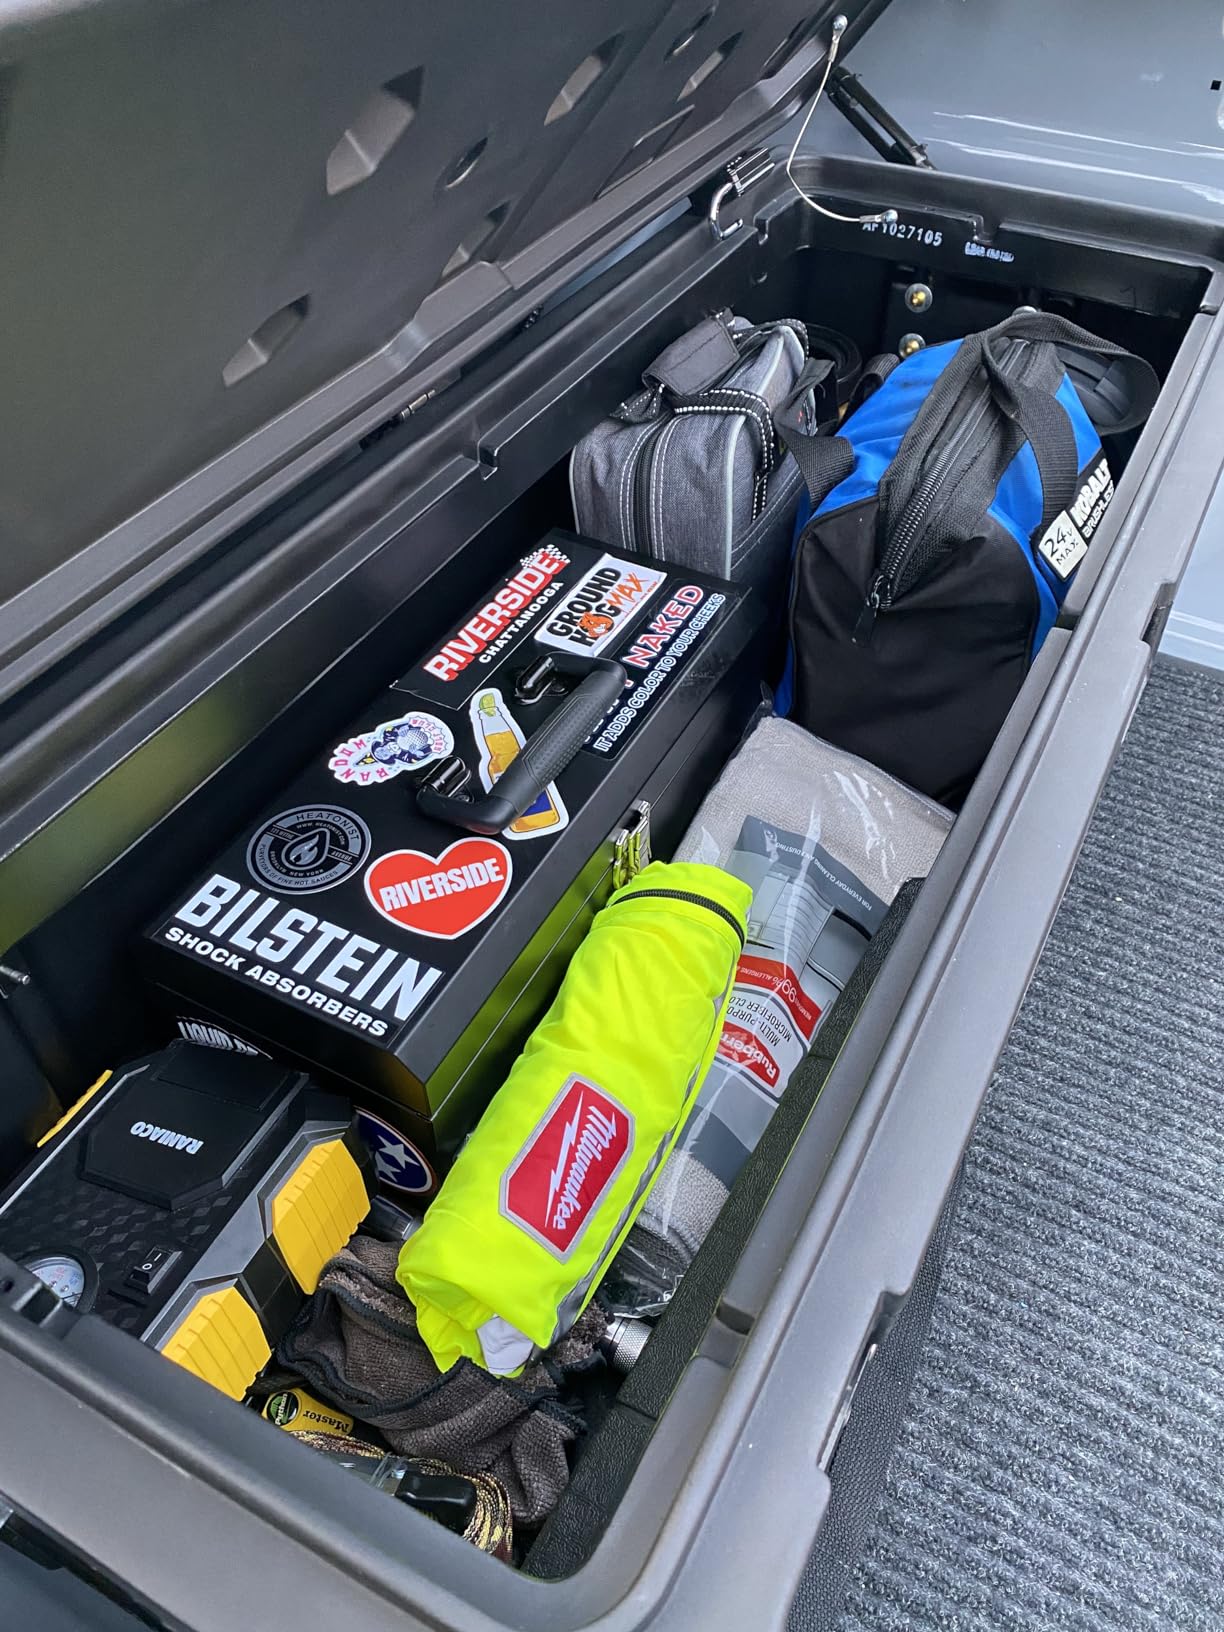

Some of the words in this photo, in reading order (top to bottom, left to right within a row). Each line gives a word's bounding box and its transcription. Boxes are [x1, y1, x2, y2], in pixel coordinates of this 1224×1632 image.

[1070, 458, 1112, 528] KOBALT
[1056, 539, 1079, 565] MAX
[546, 567, 622, 637] GROUND
[605, 572, 650, 608] MAX
[423, 550, 568, 681] RIVERSIDE
[479, 581, 565, 664] CHATTANOOGA
[622, 585, 704, 668] NAKED
[689, 592, 727, 632] CHEEKS
[667, 628, 700, 659] YOUR
[655, 656, 677, 673] TO
[628, 671, 667, 707] COLOR
[601, 706, 637, 741] ADDS
[334, 738, 390, 782] RANDOM
[593, 736, 613, 753] IT
[295, 811, 360, 841] HEATONIST
[294, 879, 309, 887] HOT
[311, 870, 339, 885] SAUCES
[306, 868, 325, 877] YORK
[378, 857, 504, 912] RIVERSIDE
[812, 858, 837, 883] CLEANING
[834, 879, 863, 903] EVERYDAY
[861, 899, 873, 911] FOR
[174, 873, 443, 1022] BILSTEIN
[164, 926, 247, 971] SHOCK
[244, 964, 389, 1037] ABSORBERS
[728, 995, 746, 1007] CLO
[726, 1005, 781, 1047] MULTI-PURPO
[746, 1001, 792, 1042] MICROFIBER
[130, 1121, 205, 1155] RANIACO
[552, 1105, 617, 1230] Milwaukee
[274, 1391, 289, 1427] Python
[302, 1409, 351, 1432] Master
